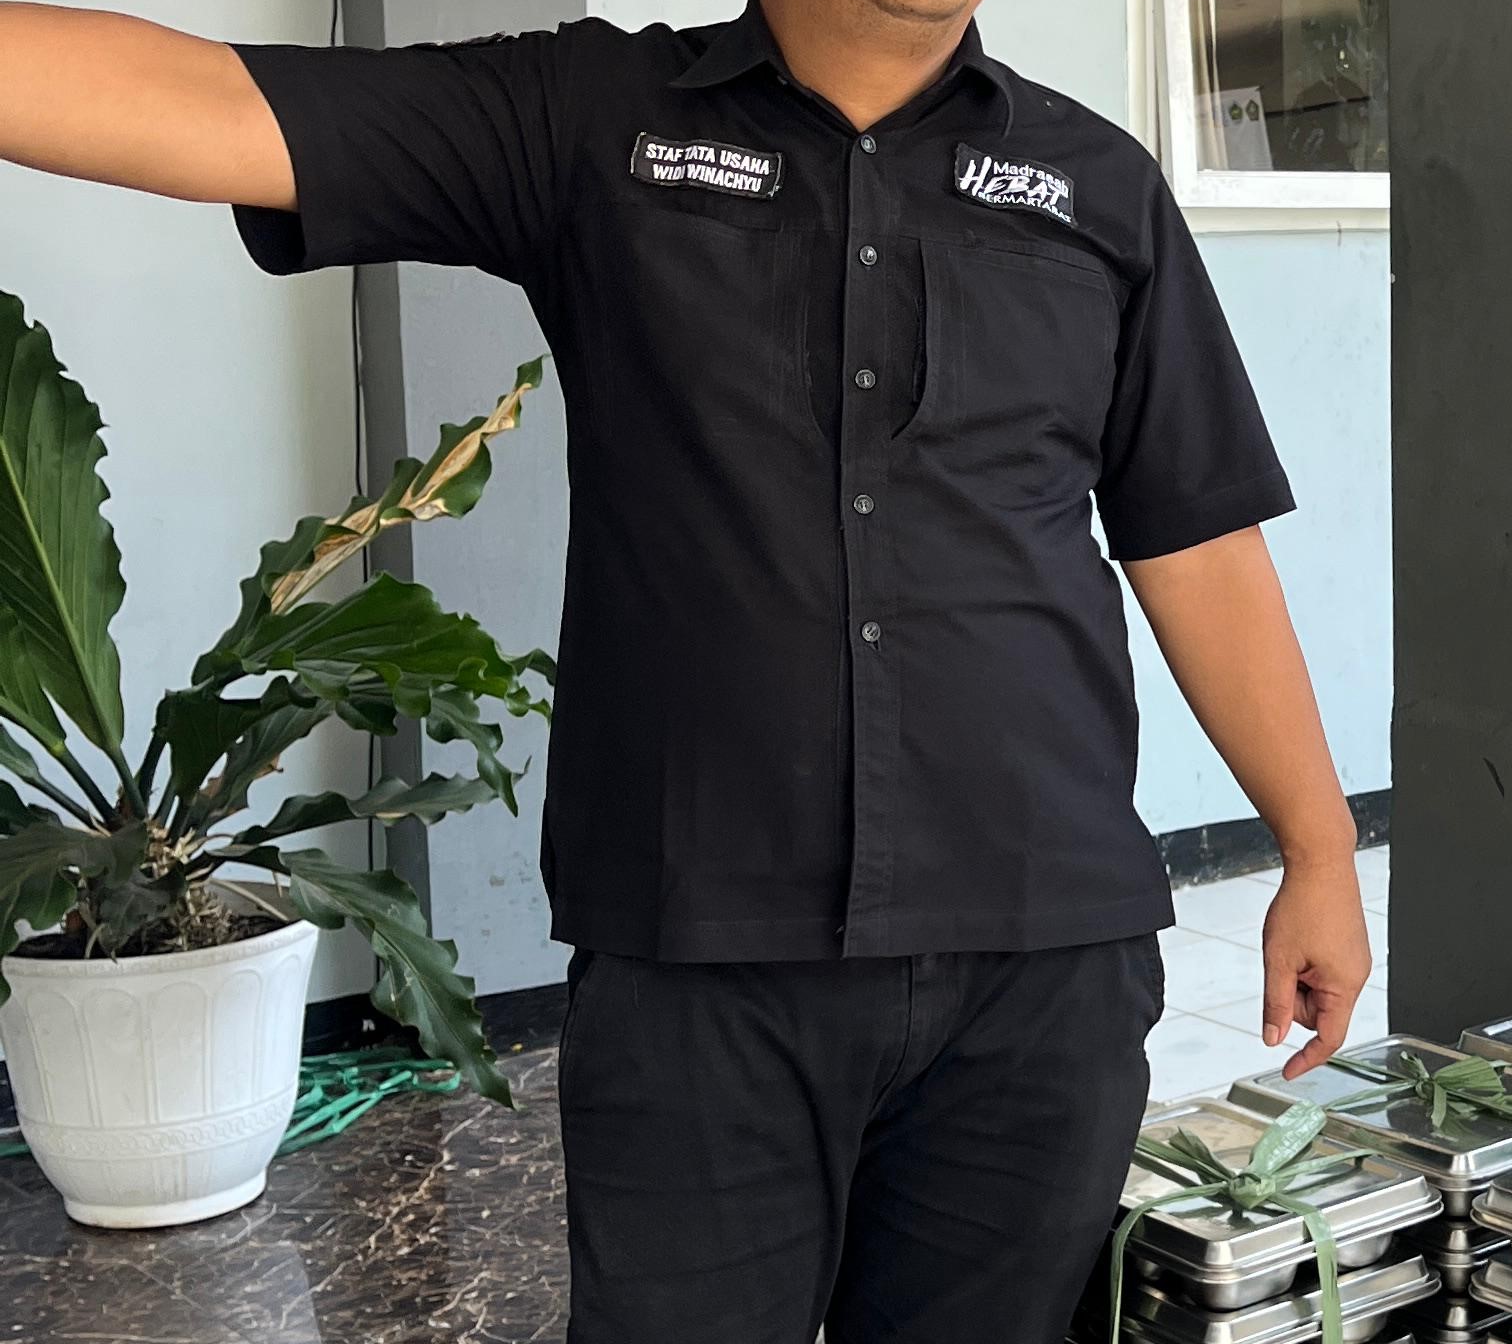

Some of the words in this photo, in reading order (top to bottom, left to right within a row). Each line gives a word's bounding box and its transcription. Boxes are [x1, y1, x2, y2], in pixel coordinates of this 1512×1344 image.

[646, 143, 684, 162] STAF
[684, 145, 716, 164] TATA
[720, 150, 770, 175] USAHA
[687, 164, 762, 193] WINACHYU
